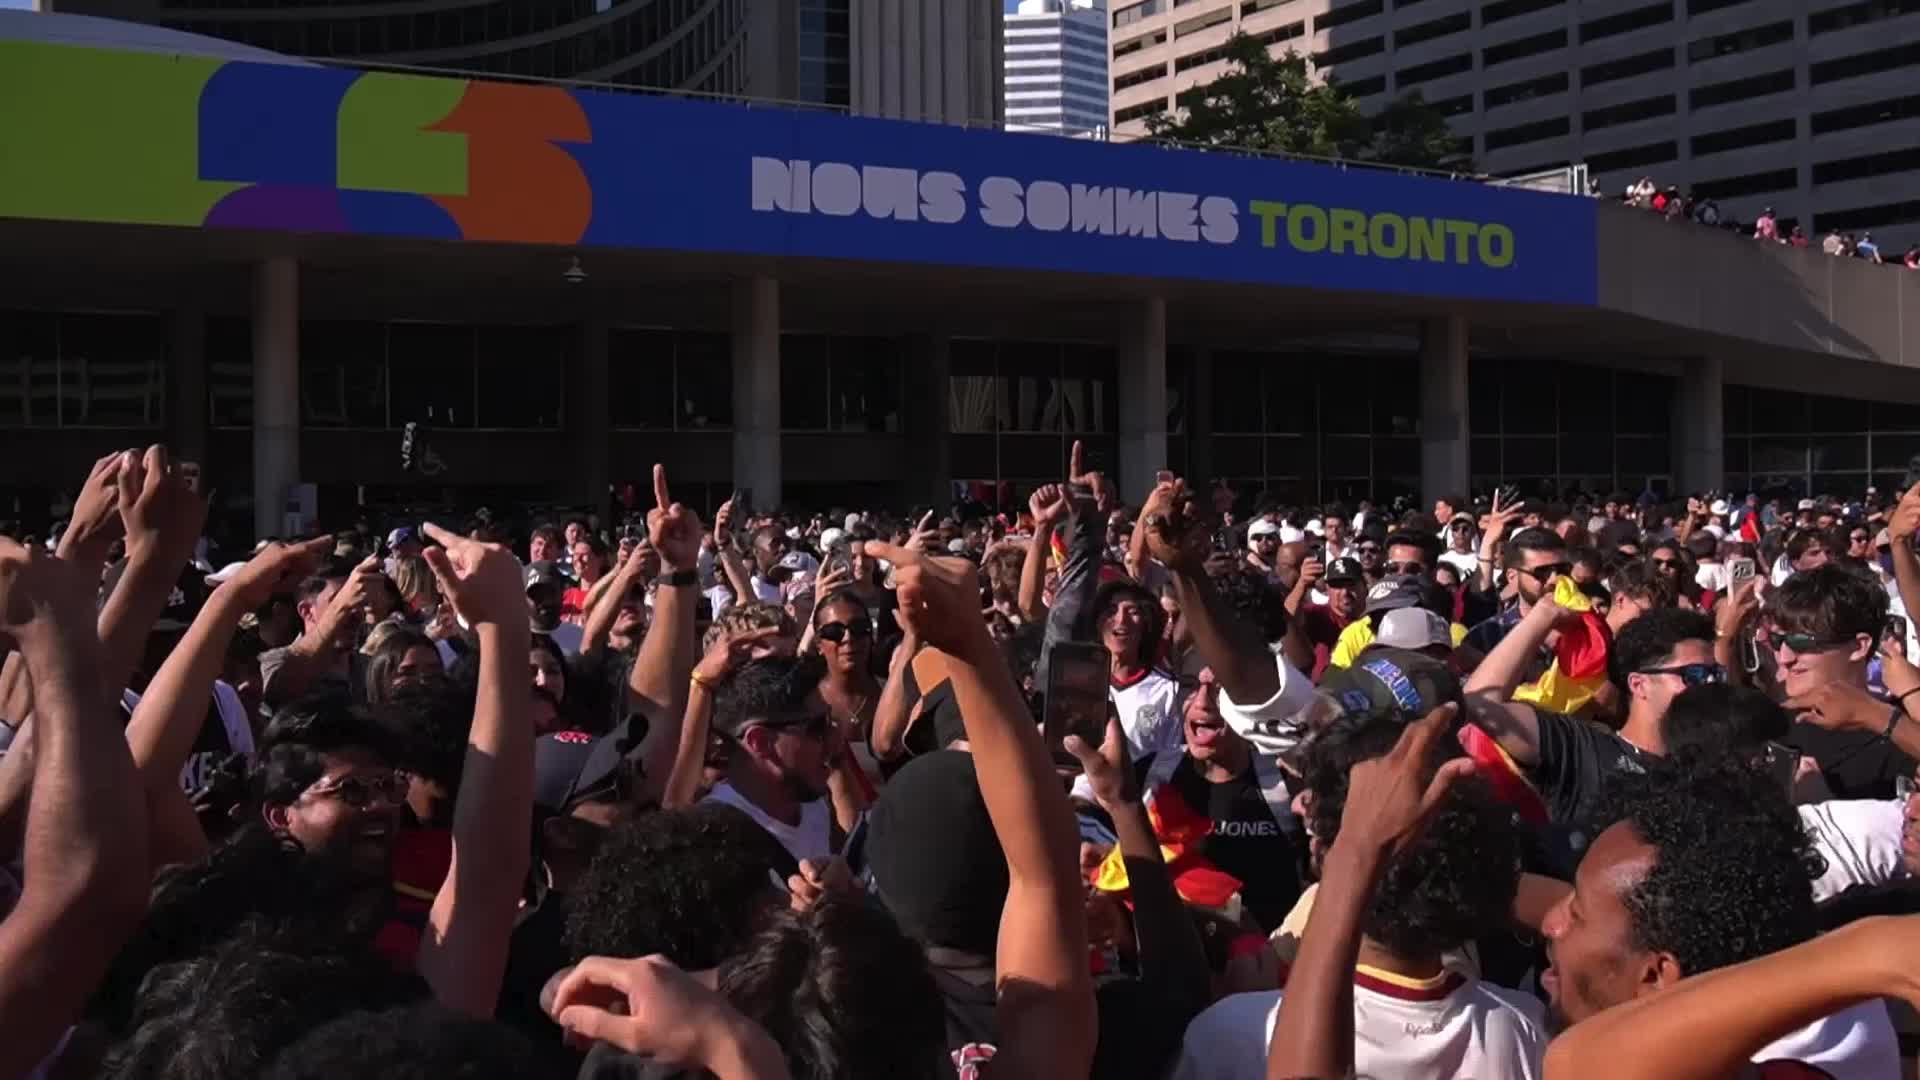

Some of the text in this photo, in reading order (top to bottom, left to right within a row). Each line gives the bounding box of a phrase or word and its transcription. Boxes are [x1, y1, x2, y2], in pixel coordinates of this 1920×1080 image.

[751, 156, 1514, 268] NOUS SOMMES TORONTO
